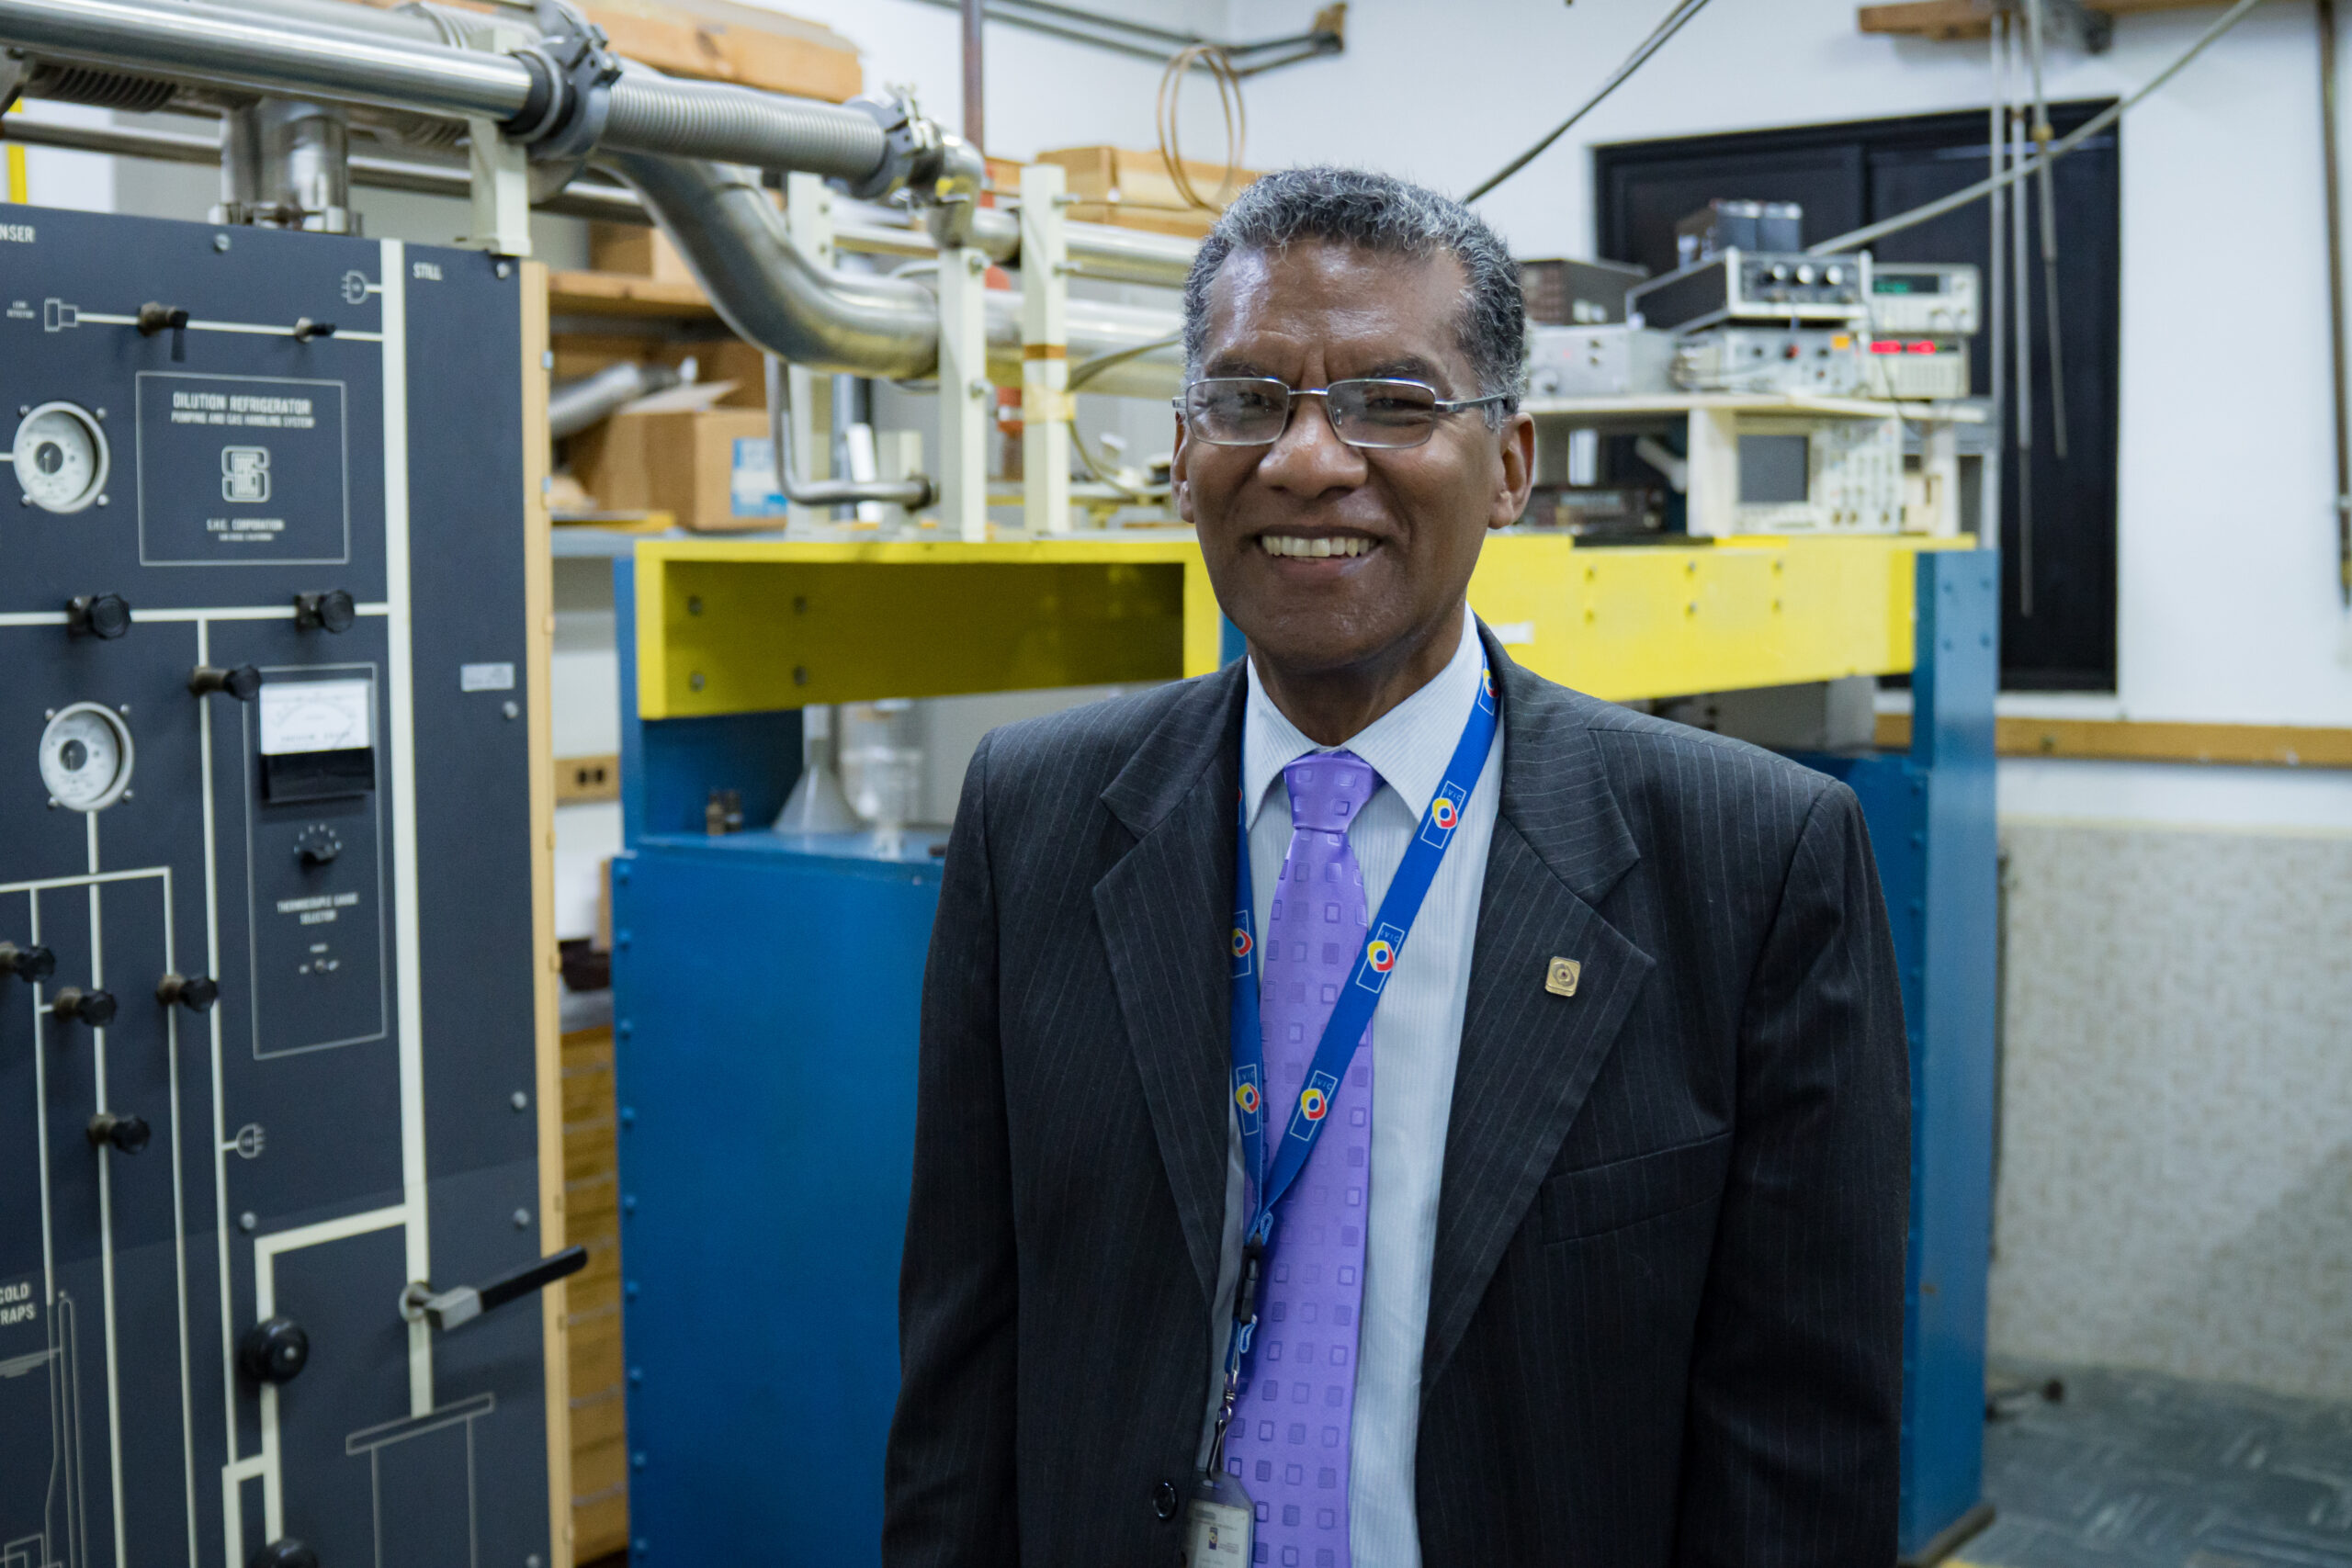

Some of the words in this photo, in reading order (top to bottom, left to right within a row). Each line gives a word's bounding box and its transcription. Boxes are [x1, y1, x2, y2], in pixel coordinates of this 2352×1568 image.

[173, 391, 227, 411] DILUTION
[230, 395, 312, 415] REFRIGERATOR
[1380, 930, 1400, 942] IVIC
